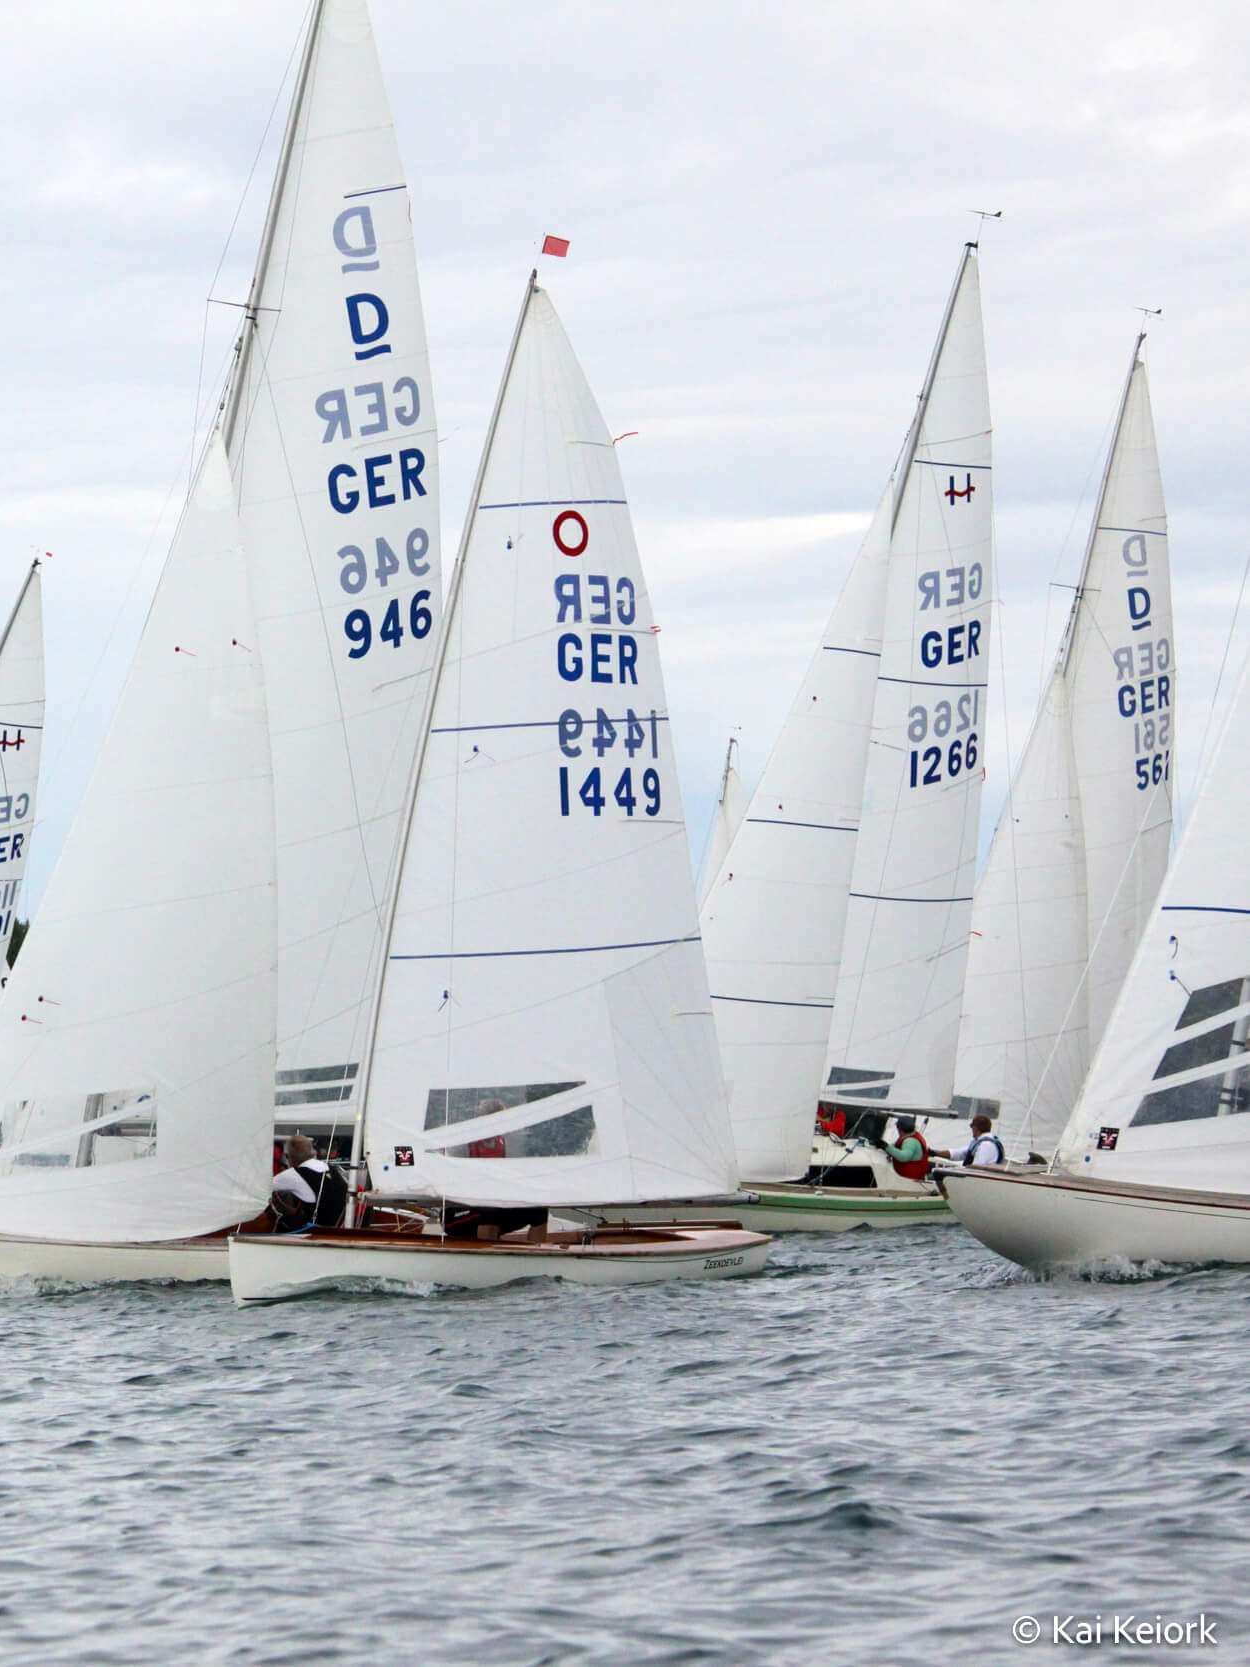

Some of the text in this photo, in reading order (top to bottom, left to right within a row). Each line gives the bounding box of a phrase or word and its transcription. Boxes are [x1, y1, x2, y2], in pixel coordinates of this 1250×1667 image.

[345, 292, 390, 345] D
[327, 447, 428, 515] GER
[343, 589, 432, 659] 946
[1127, 586, 1152, 621] D
[557, 632, 638, 685] GER
[921, 619, 982, 669] GER
[1118, 676, 1170, 718] GER
[910, 733, 978, 788] 1266
[1135, 750, 1169, 791] 561
[559, 766, 661, 817] 1449
